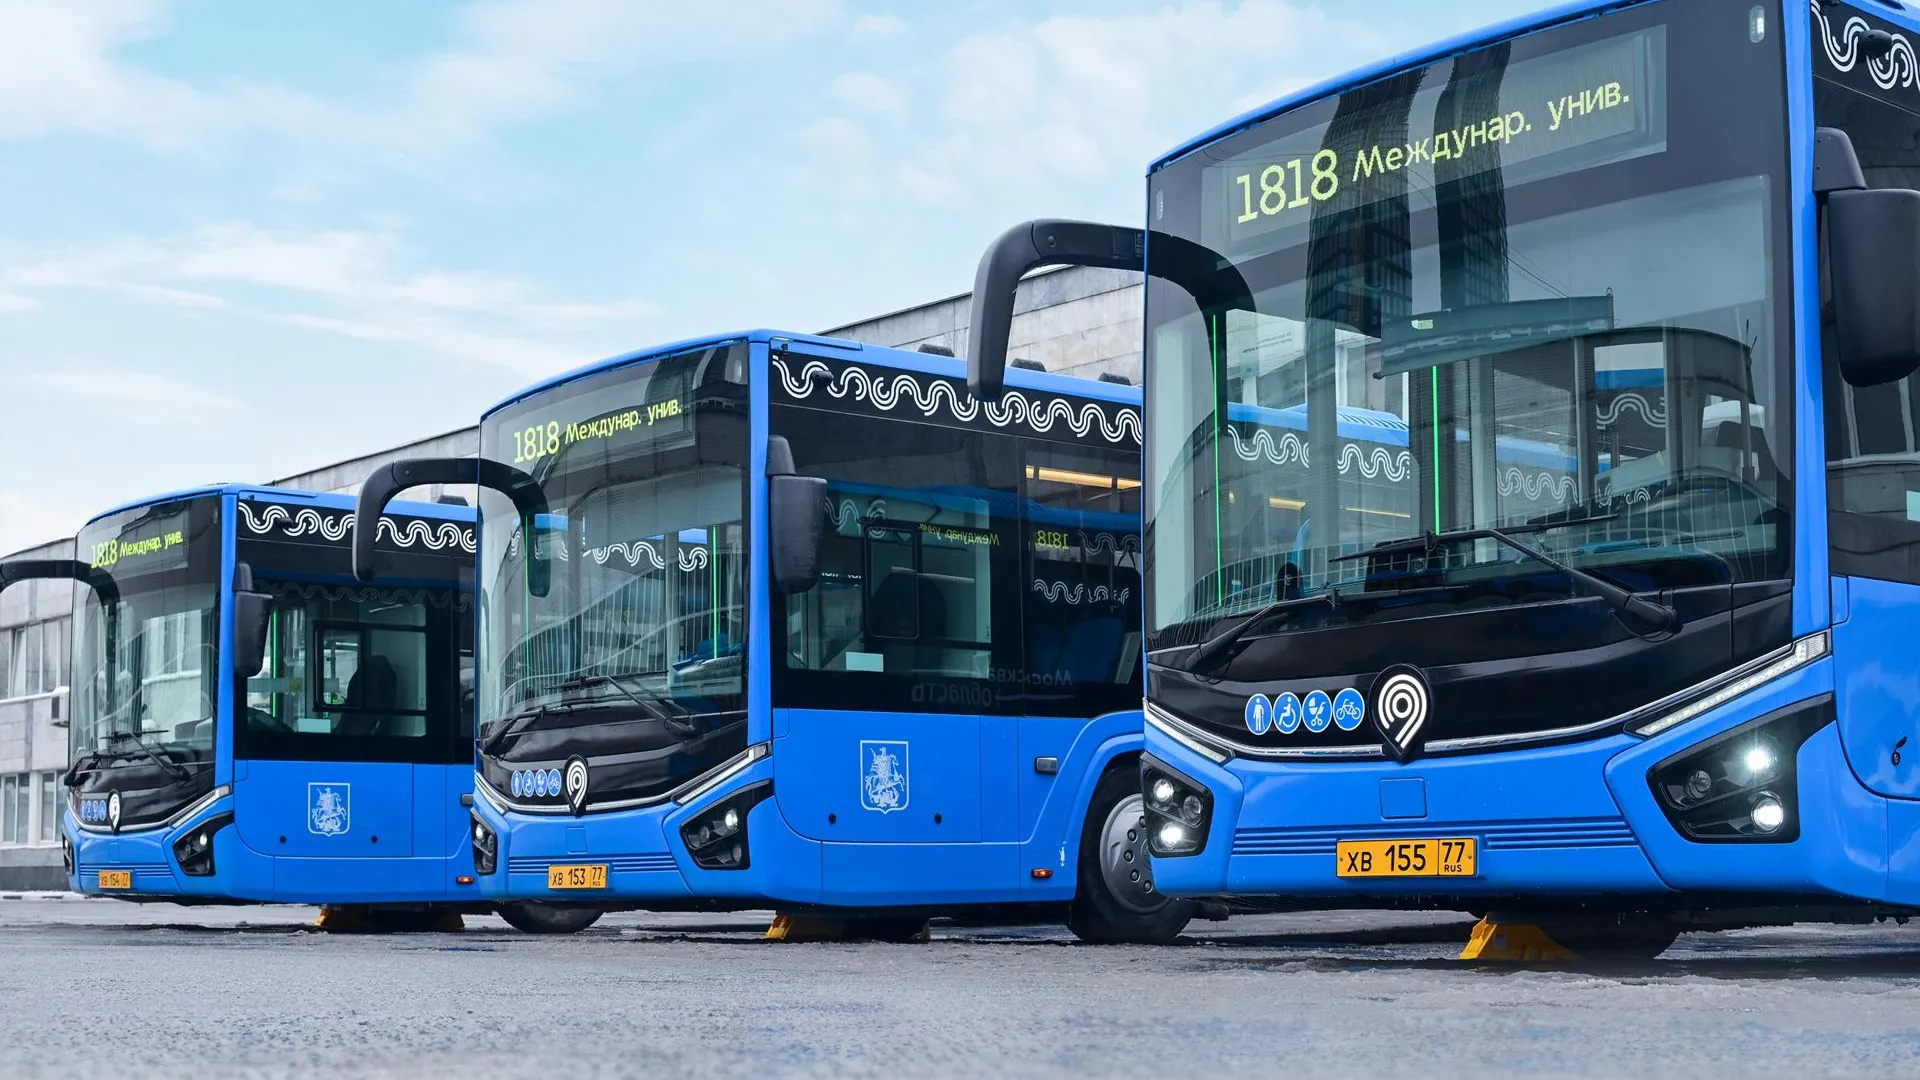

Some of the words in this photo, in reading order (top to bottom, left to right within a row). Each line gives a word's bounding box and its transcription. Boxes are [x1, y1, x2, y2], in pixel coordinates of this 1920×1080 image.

[1236, 149, 1339, 224] 1818
[1352, 109, 1532, 182] Междунар.
[1547, 81, 1630, 131] унив.
[514, 421, 560, 463] 1818
[565, 410, 641, 444] Междунар.
[647, 399, 681, 426] унив.
[91, 538, 118, 569] 1818
[120, 536, 161, 558] Междунар.
[164, 531, 183, 549] унив.
[1385, 844, 1426, 872] 155
[1442, 842, 1465, 863] 77
[1444, 864, 1462, 873] RUS
[568, 868, 586, 885] 153
[592, 867, 602, 881] 77
